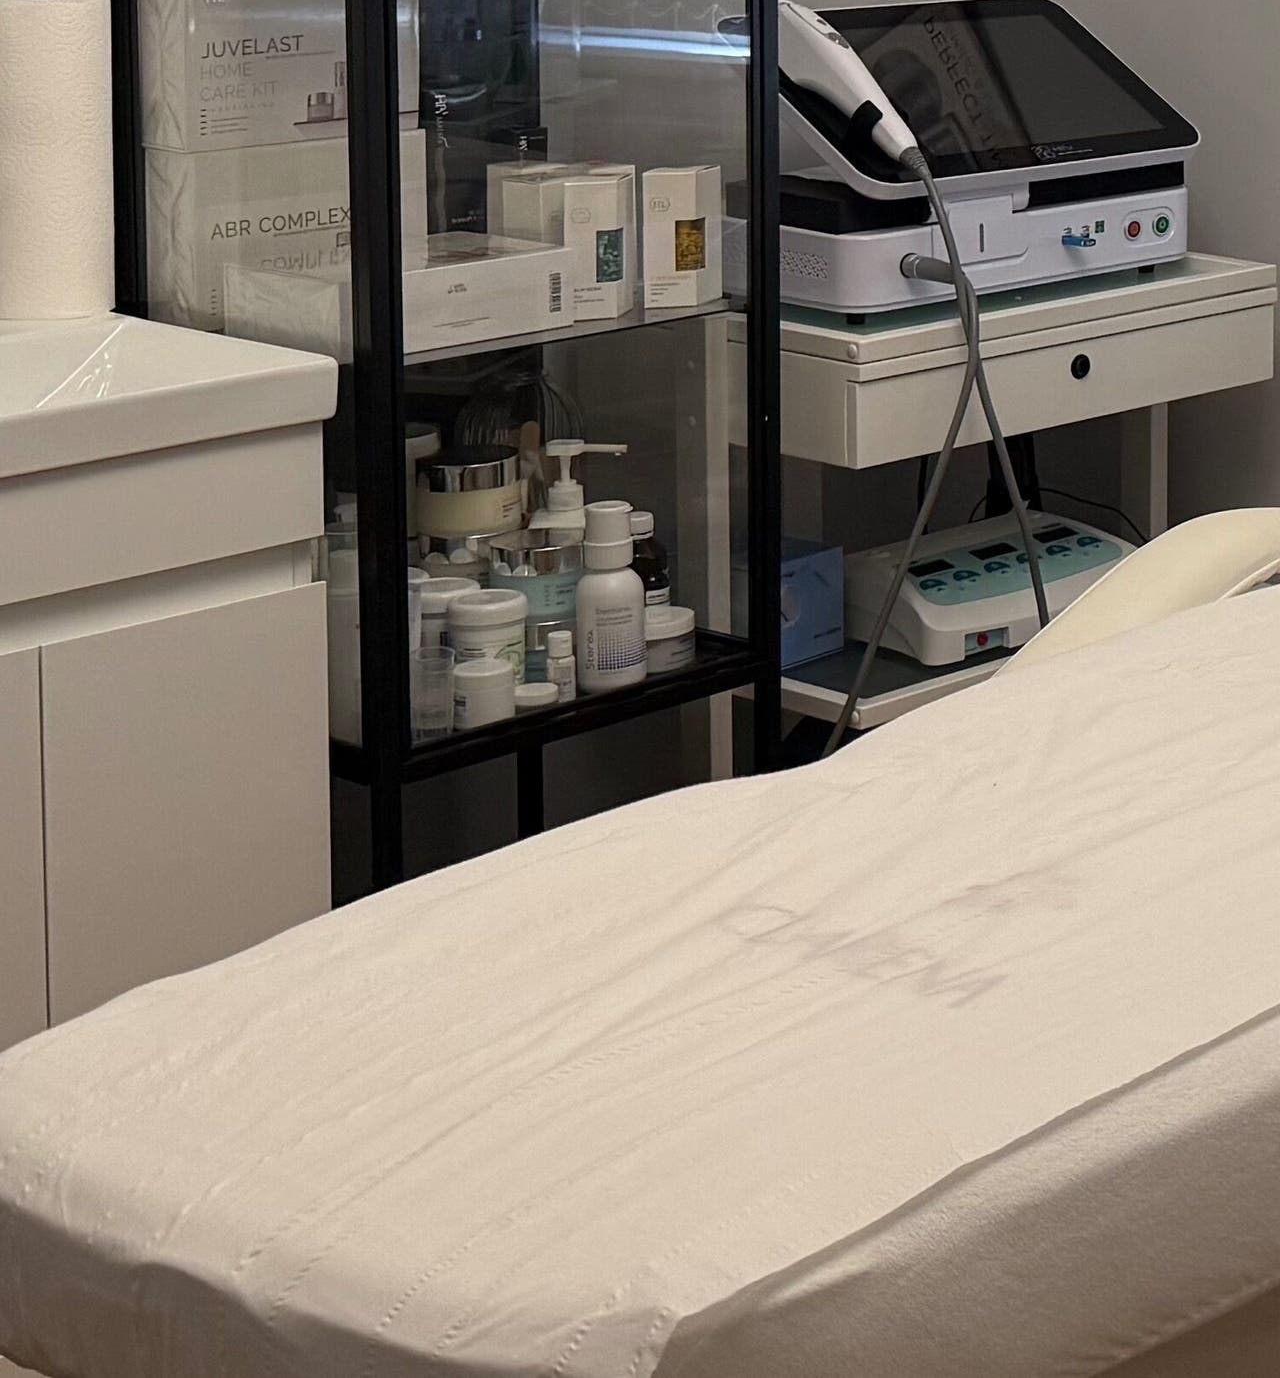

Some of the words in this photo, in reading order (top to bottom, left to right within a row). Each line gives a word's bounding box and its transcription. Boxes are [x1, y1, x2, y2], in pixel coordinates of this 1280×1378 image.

[201, 34, 305, 59] JUVELAST
[200, 61, 252, 80] HOME
[200, 83, 247, 102] CARE
[252, 79, 278, 95] KIT
[210, 219, 251, 240] ABR
[259, 206, 351, 233] COMPLEX
